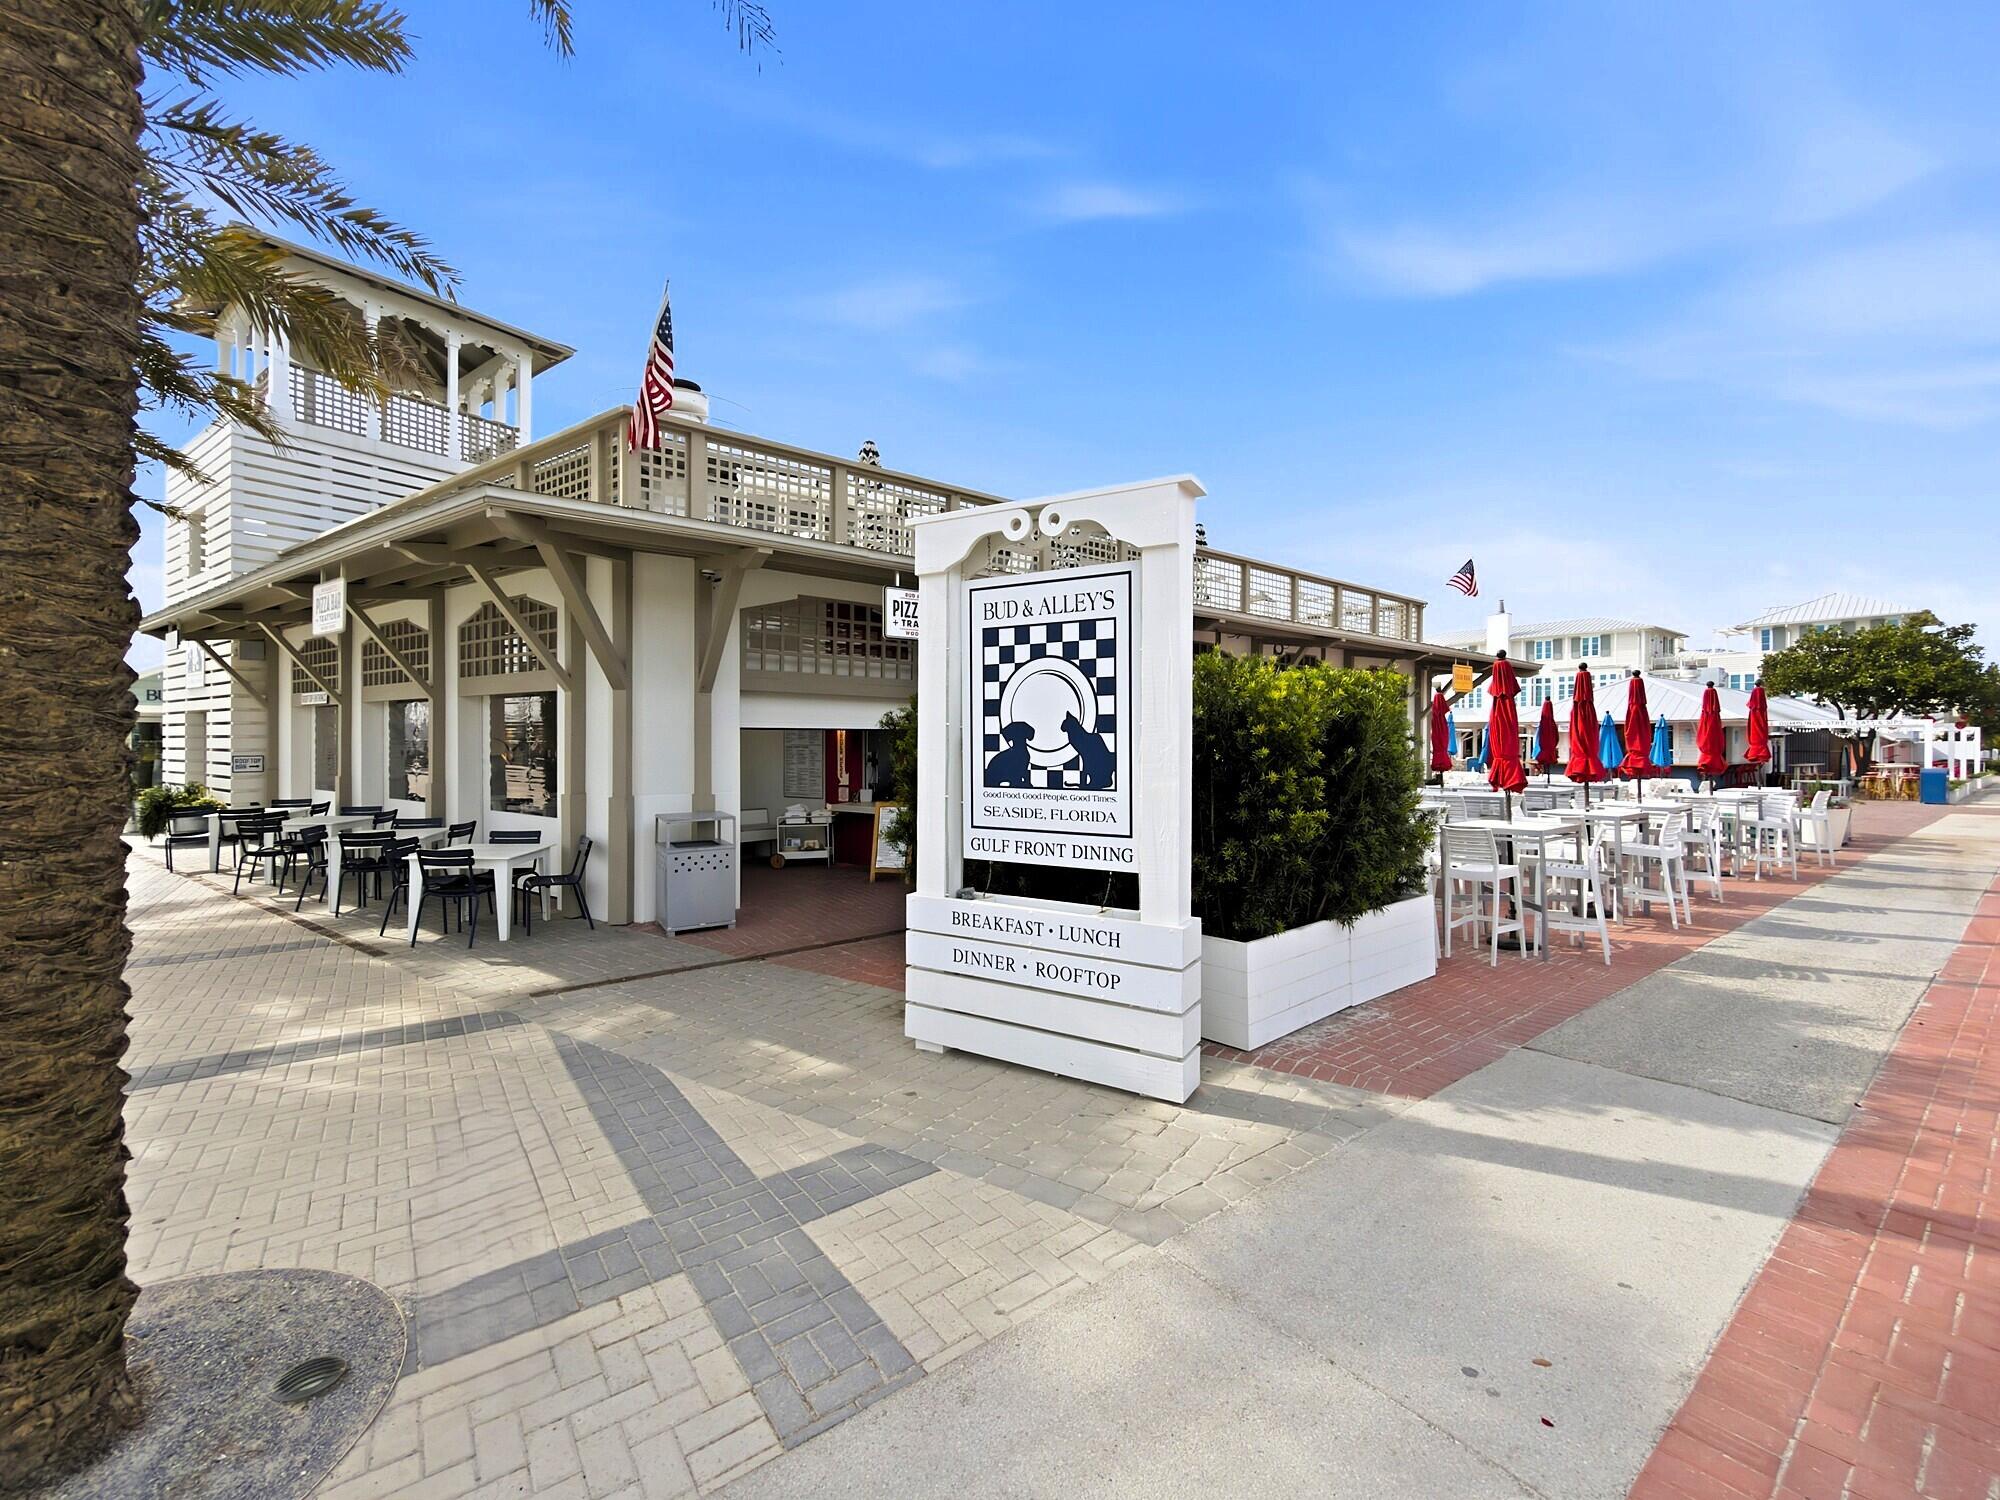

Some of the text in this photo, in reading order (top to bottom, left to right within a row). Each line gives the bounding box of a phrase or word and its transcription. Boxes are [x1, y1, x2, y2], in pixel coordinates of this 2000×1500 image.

[983, 590, 1115, 620] BUD & ALLEY'S
[983, 791, 1001, 799] Good
[1022, 792, 1042, 800] Good
[1069, 794, 1090, 802] Good
[983, 805, 1117, 823] SEASIDE, FLORIDA
[970, 837, 1134, 863] GULF FRONT DINING
[951, 910, 1121, 948] BREAKFAST LUNCH
[953, 948, 1121, 990] DINNER ROOFTOP
